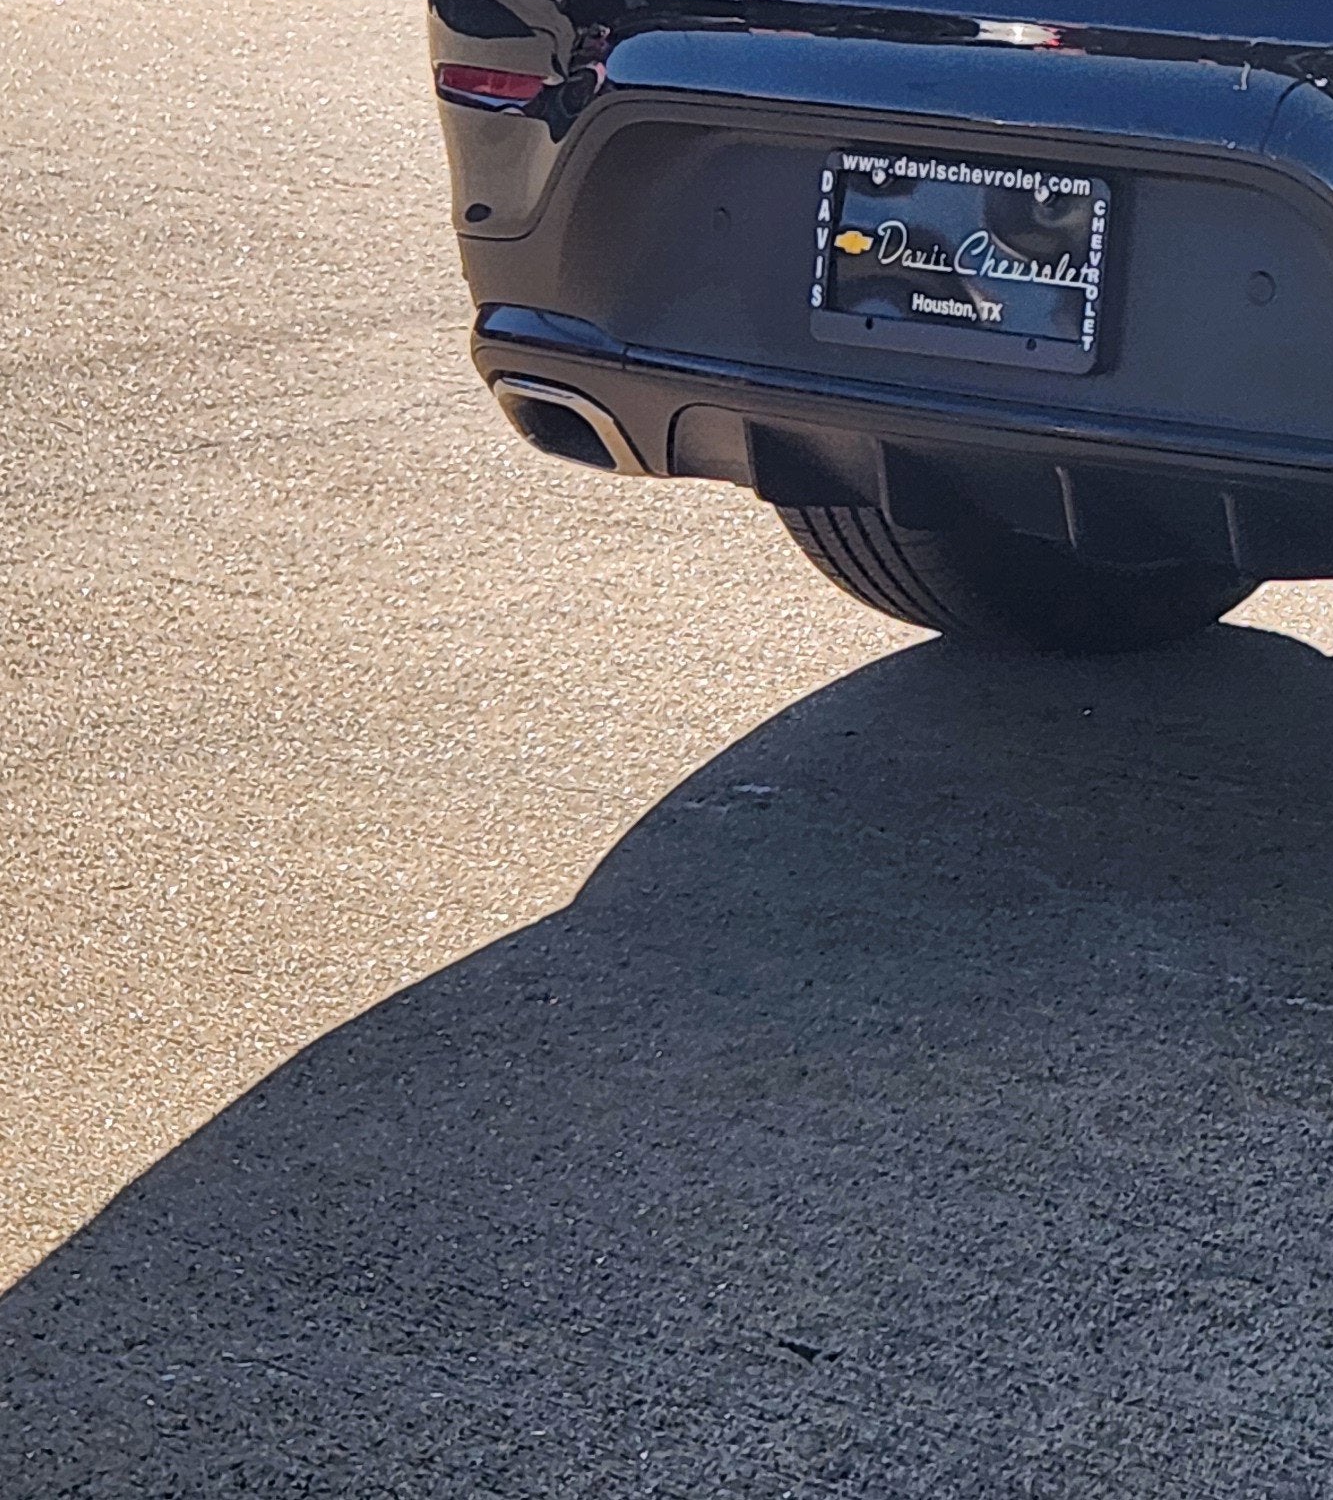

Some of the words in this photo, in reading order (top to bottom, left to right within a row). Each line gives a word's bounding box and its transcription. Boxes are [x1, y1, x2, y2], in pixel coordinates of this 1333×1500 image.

[842, 153, 1092, 196] www.davischevrolet.com
[811, 170, 834, 307] DAVIS
[877, 219, 953, 272] Davis
[953, 230, 1090, 289] Chevrolet
[912, 292, 978, 322] Houston,
[979, 301, 1004, 322] TX
